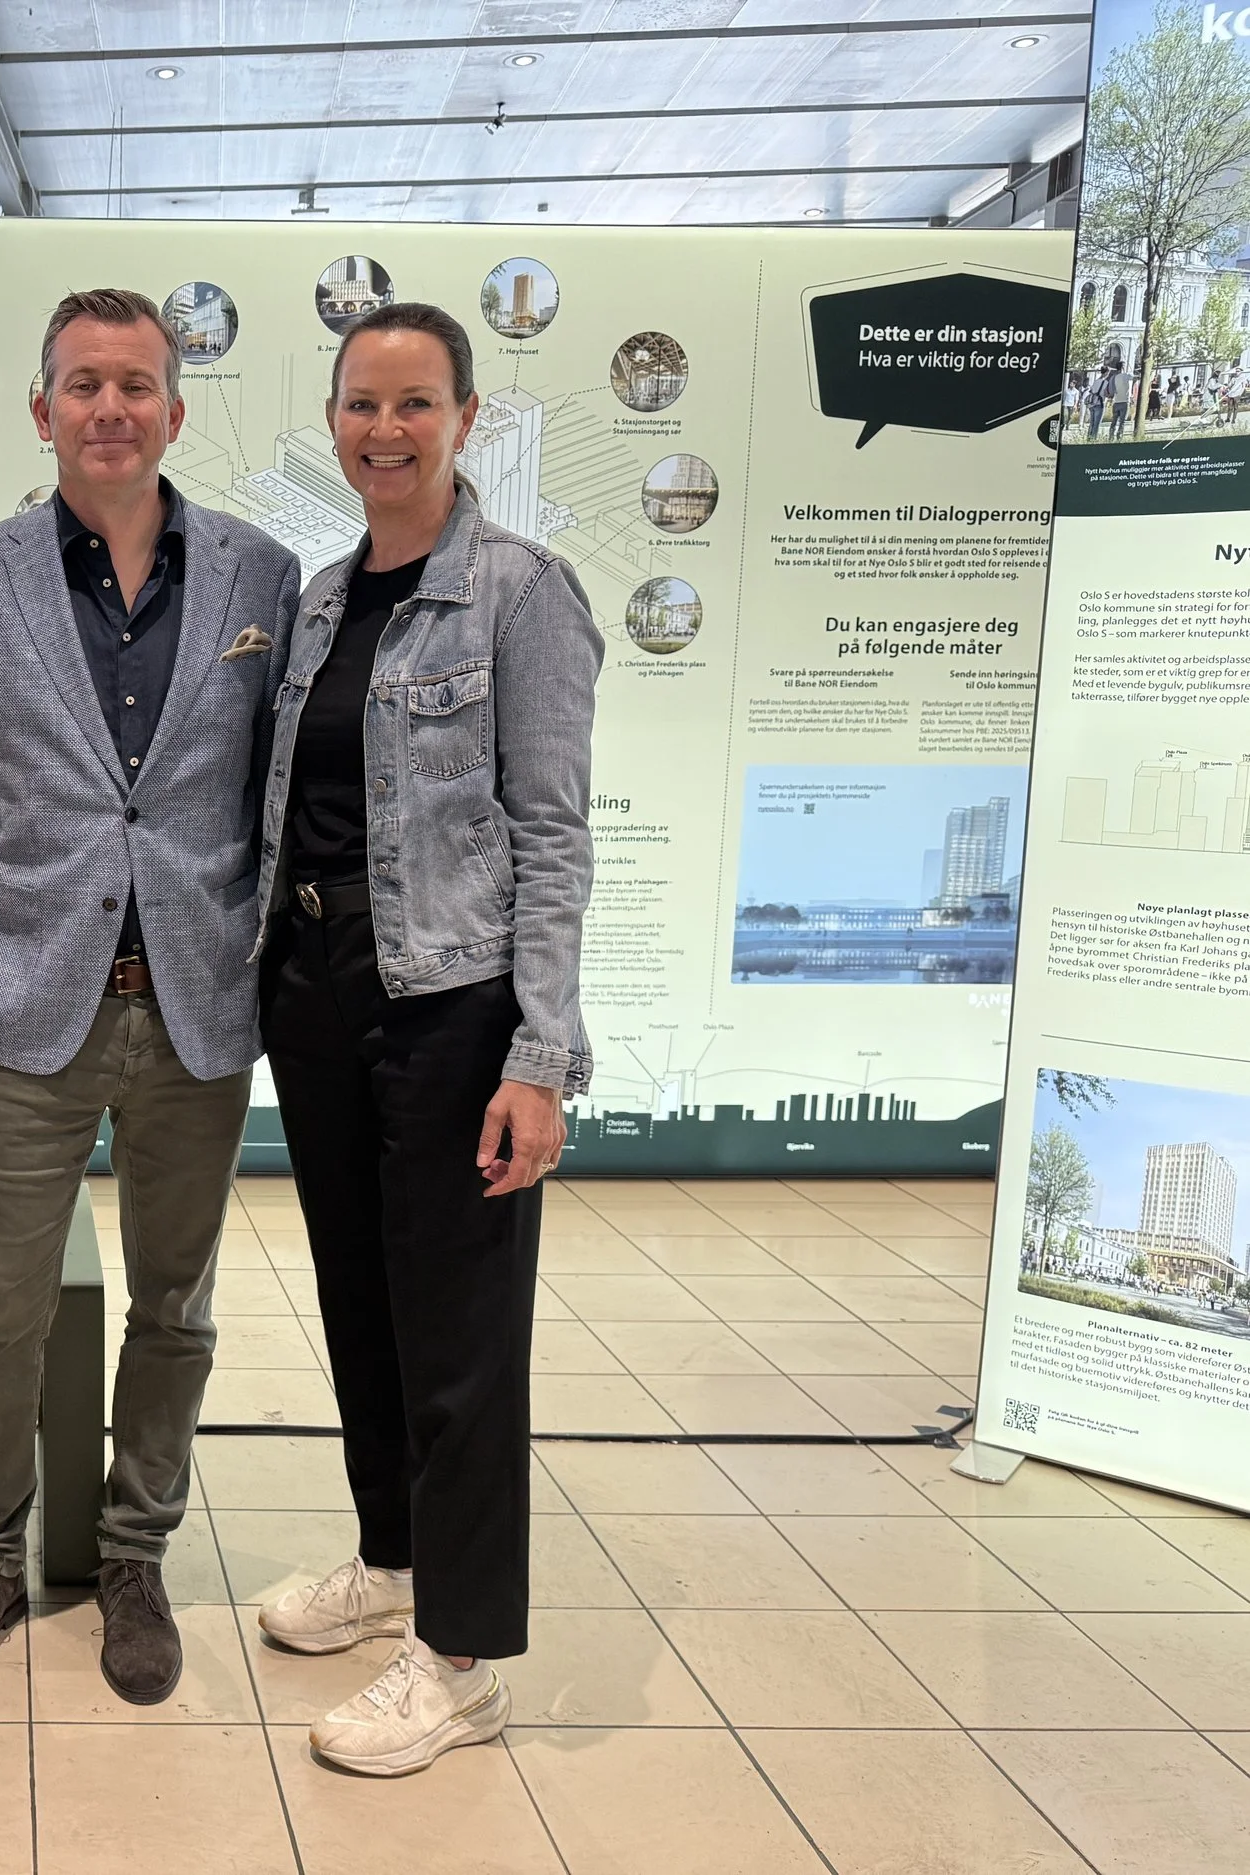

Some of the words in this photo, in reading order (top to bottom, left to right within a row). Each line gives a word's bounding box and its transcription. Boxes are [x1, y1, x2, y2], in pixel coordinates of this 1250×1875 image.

[859, 324, 911, 342] Dette
[914, 329, 934, 342] er
[937, 324, 967, 342] din
[971, 326, 1044, 347] stasjon!
[859, 350, 892, 367] Hva
[896, 354, 915, 368] er
[918, 350, 965, 372] viktig
[969, 350, 994, 368] for
[997, 351, 1040, 373] deg?
[614, 418, 621, 426] 4.
[621, 418, 671, 427] Stasjonstorget
[612, 427, 670, 437] Stasjonsinngang
[1190, 455, 1210, 464] reiser
[784, 504, 891, 521] Velkommen
[896, 505, 914, 521] til
[919, 505, 1051, 526] Dialogperrong
[655, 539, 673, 547] Øvre
[673, 539, 710, 548] trafikktorg
[1080, 590, 1103, 600] Oslo
[1104, 590, 1110, 600] S
[1123, 590, 1195, 600] hovedstadens
[826, 617, 850, 632] Du
[855, 616, 888, 632] kan
[893, 617, 980, 637] engasjere
[985, 617, 1018, 637] deg
[838, 638, 860, 658] på
[865, 638, 945, 658] følgende
[949, 638, 1003, 655] måter
[1074, 654, 1092, 663] Her
[1093, 654, 1126, 664] samles
[1126, 654, 1166, 664] aktivitet
[1167, 657, 1181, 666] og
[624, 660, 655, 668] Christian
[656, 660, 688, 671] Frederiks
[688, 661, 706, 669] plass
[769, 668, 794, 676] Svare
[795, 668, 807, 678] på
[950, 670, 977, 678] Sende
[978, 670, 993, 678] inn
[994, 670, 1038, 680] høringsin
[784, 679, 793, 688] til
[795, 679, 817, 688] Bane
[818, 679, 838, 688] NOR
[839, 679, 878, 688] Eiendom
[965, 681, 975, 689] til
[976, 681, 996, 689] Oslo
[596, 823, 657, 833] oppgradering
[610, 834, 671, 844] sammenheng.
[601, 857, 636, 865] utvikles
[1166, 905, 1212, 918] planlagt
[1214, 909, 1250, 919] plasse
[1050, 930, 1067, 941] Det
[1069, 932, 1097, 945] ligger
[1116, 937, 1130, 947] for
[1132, 939, 1161, 950] aksen
[1164, 941, 1177, 951] fra
[1180, 943, 1200, 954] Karl
[1202, 946, 1238, 957] Johans
[606, 1119, 635, 1127] Christian
[1087, 1320, 1160, 1342] Planalternativ
[1168, 1339, 1183, 1348] ca.
[1185, 1341, 1198, 1351] 82
[1200, 1346, 1233, 1358] meter
[1010, 1360, 1019, 1368] til
[1020, 1362, 1036, 1373] det
[1038, 1366, 1083, 1384] historiske
